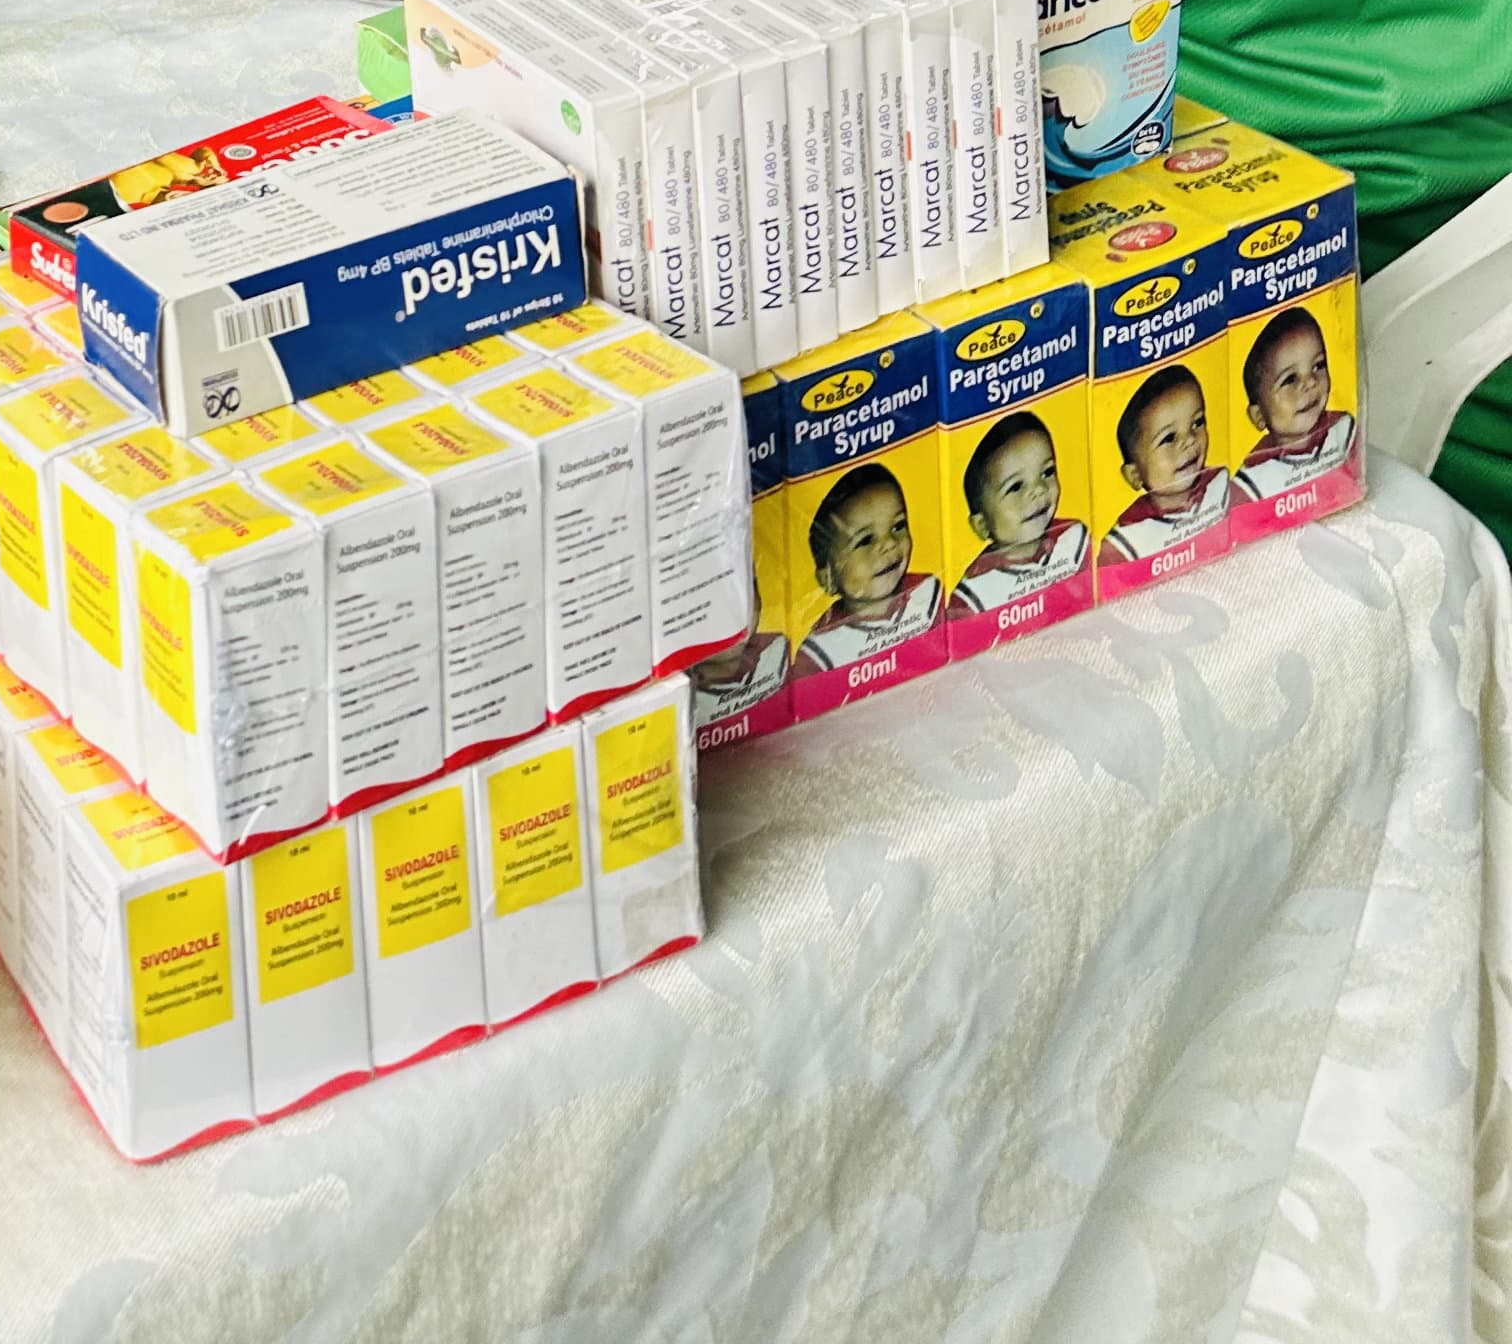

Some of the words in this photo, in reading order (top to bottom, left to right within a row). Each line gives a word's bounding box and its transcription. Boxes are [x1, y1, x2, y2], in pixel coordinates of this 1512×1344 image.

[926, 97, 939, 150] 80/480
[970, 82, 985, 137] 80/480
[1013, 70, 1028, 125] 80/480
[840, 120, 855, 176] 80/480
[878, 104, 893, 160] 80/480
[764, 151, 779, 209] 80/480
[804, 138, 819, 194] 80/480
[966, 145, 988, 234] Marcat
[1008, 133, 1031, 222] Marcat
[616, 191, 632, 248] 80/480
[665, 178, 682, 236] 80/480
[715, 167, 730, 225] 80/480
[874, 168, 897, 260] Marcat
[920, 159, 942, 248] Marcat
[392, 240, 441, 267] Tablets
[442, 204, 554, 251] Chlorpheniramine
[799, 203, 823, 295] Marcat
[836, 185, 859, 278] Marcat
[1250, 230, 1295, 255] Peace
[337, 263, 368, 283] 4mg
[370, 255, 392, 276] BP
[402, 224, 561, 316] Krisfed
[711, 232, 736, 328] Marcat
[759, 217, 783, 310] Marcat
[1231, 228, 1347, 290] Paracetamol
[1265, 266, 1318, 301] Syrup
[552, 293, 564, 304] 10
[660, 245, 686, 339] Marcat
[1102, 280, 1224, 348] Paracetamol
[1125, 286, 1172, 312] Peace
[82, 282, 147, 363] Krisfed
[465, 313, 499, 332] Tablets
[968, 330, 1017, 358] Peace
[1140, 321, 1196, 359] Syrup
[950, 326, 1076, 392] Paracetamol
[795, 375, 928, 445] Paracetamol
[814, 380, 864, 408] Peace
[987, 367, 1045, 405] Syrup
[611, 444, 629, 459] Oral
[834, 419, 895, 457] Syrup
[1275, 484, 1318, 518] 60ml
[1151, 543, 1196, 577] 60ml
[998, 596, 1044, 630] 60ml
[848, 655, 897, 689] 60ml
[698, 715, 750, 750] 60ml
[499, 803, 571, 842] SIVODAZOLE
[384, 844, 459, 883] SIVODAZOLE
[264, 886, 342, 926] SIVODAZOLE
[139, 932, 220, 972] SIVODAZOLE
